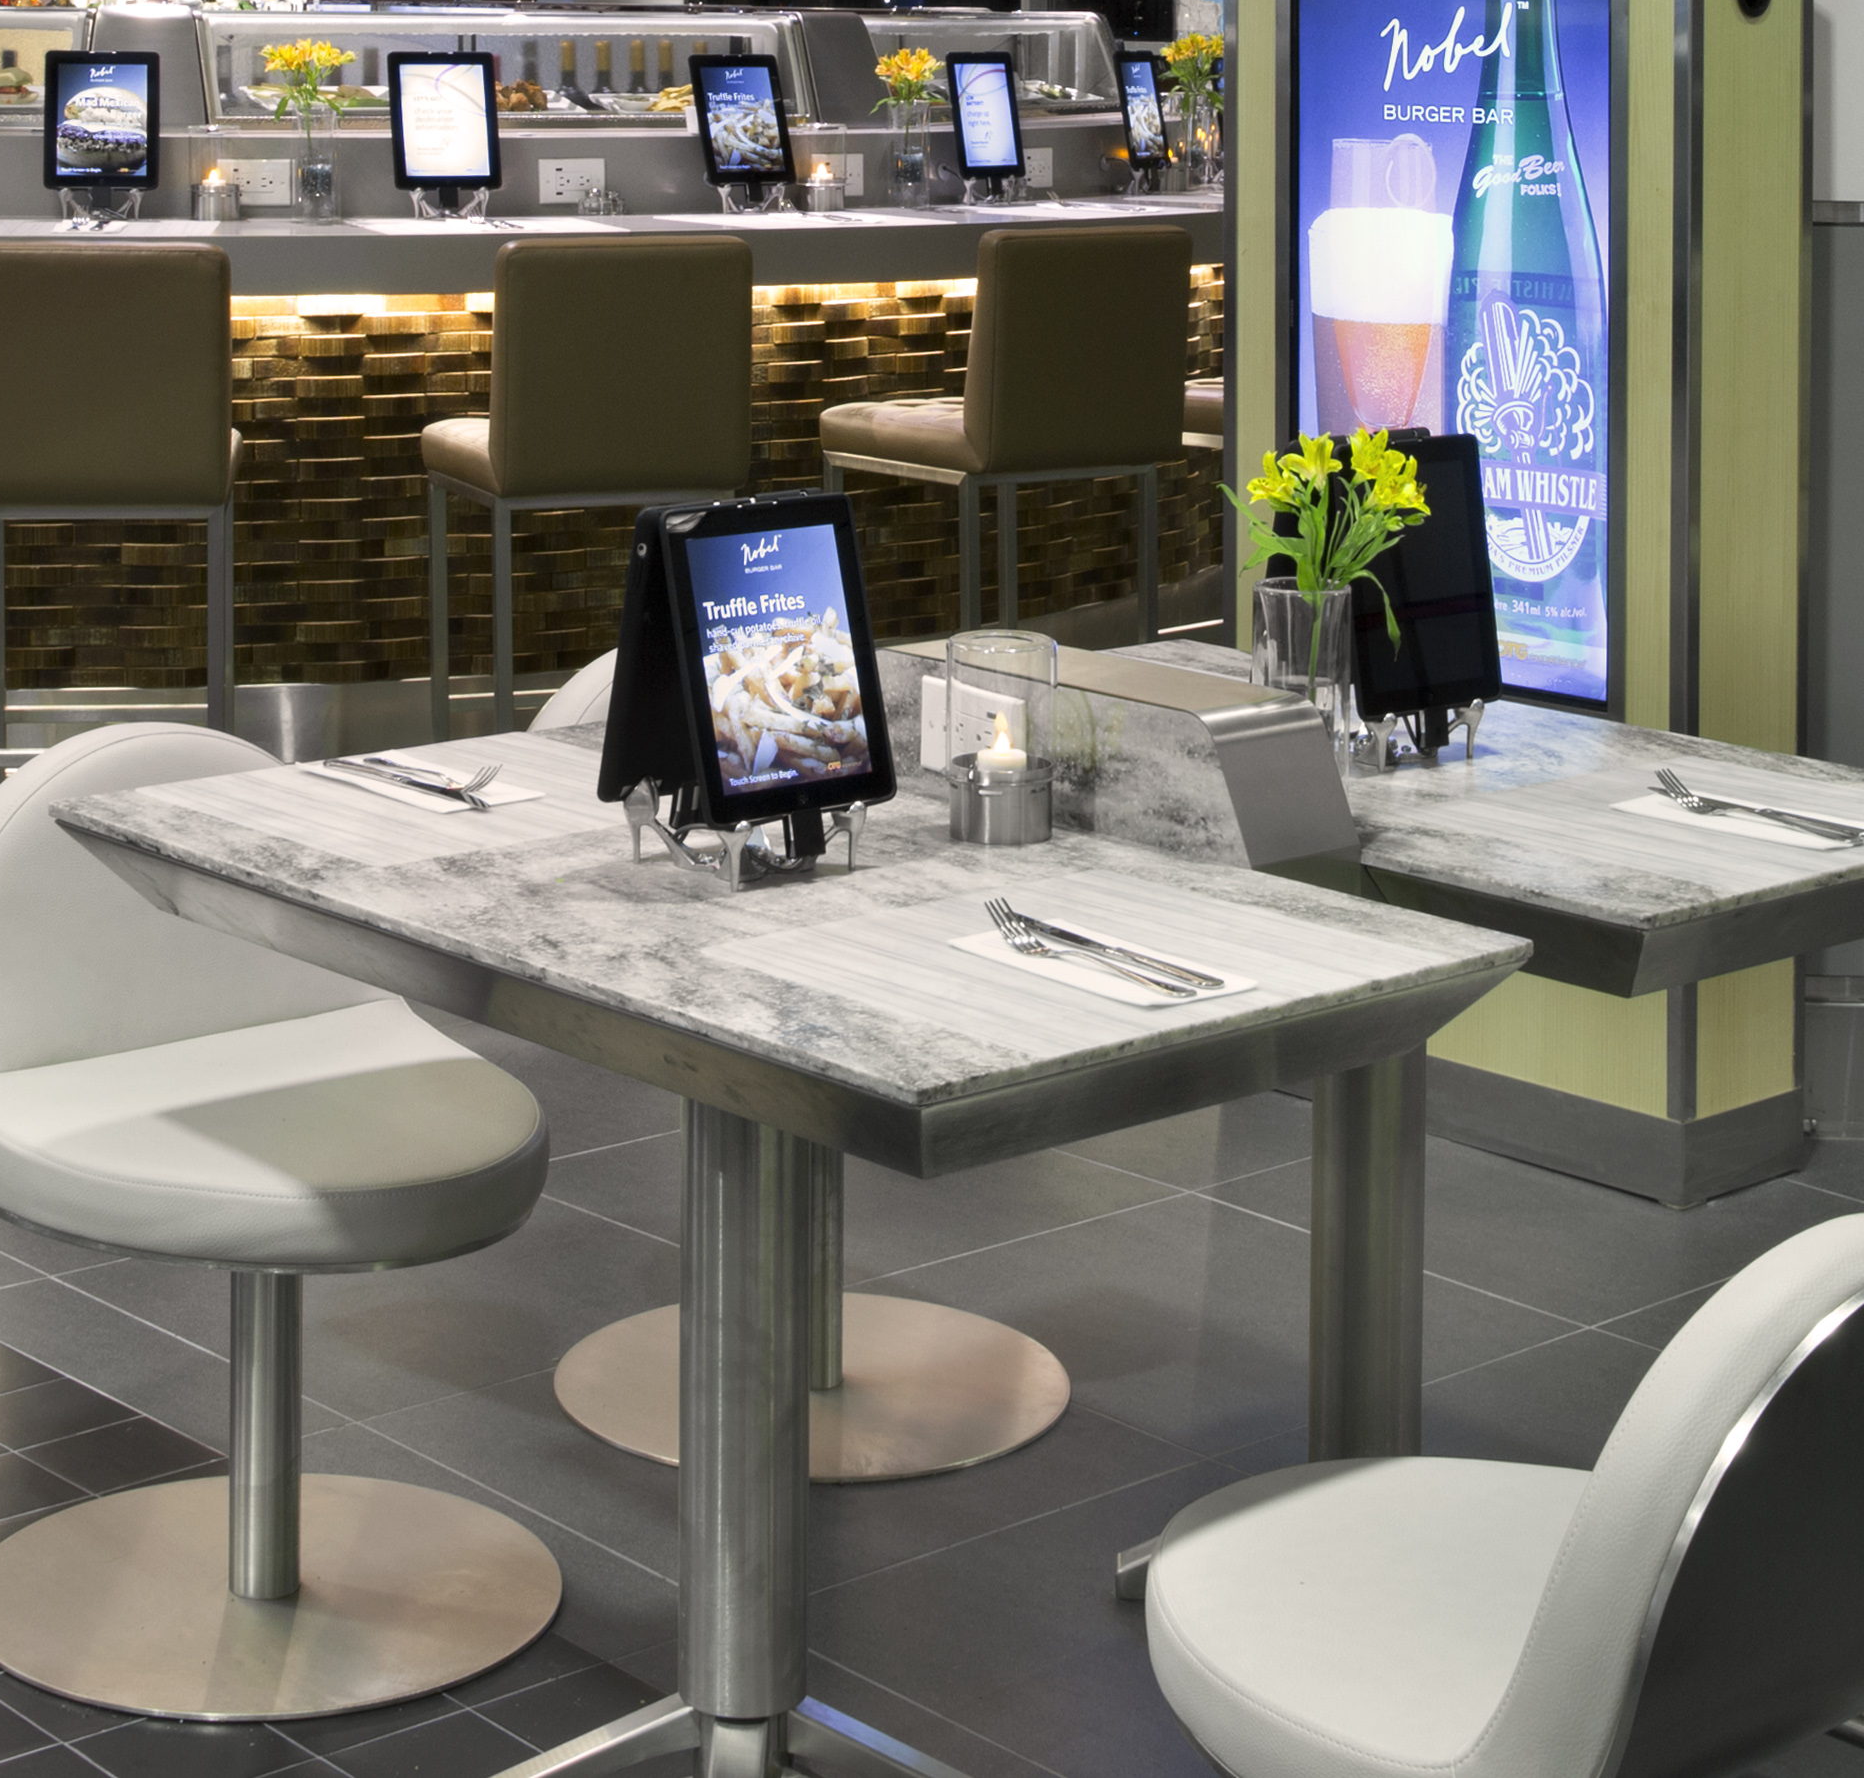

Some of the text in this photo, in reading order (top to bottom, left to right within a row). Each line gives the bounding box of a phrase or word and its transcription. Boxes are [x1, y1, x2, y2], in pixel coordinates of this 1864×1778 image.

[1383, 104, 1515, 125] BURGER BAR
[1492, 154, 1514, 166] THE
[1472, 154, 1565, 199] Good Beer
[1521, 183, 1562, 198] FOLKS!
[1515, 469, 1597, 510] WHISTLE
[1508, 562, 1553, 576] PREMIUM
[1556, 526, 1584, 567] PILSNER
[702, 593, 805, 621] Truffle Frites
[1512, 599, 1541, 616] 341ml
[1545, 606, 1558, 618] 5%
[706, 624, 744, 639] hand-cut
[729, 777, 748, 787] Touch
[749, 775, 770, 785] Screen
